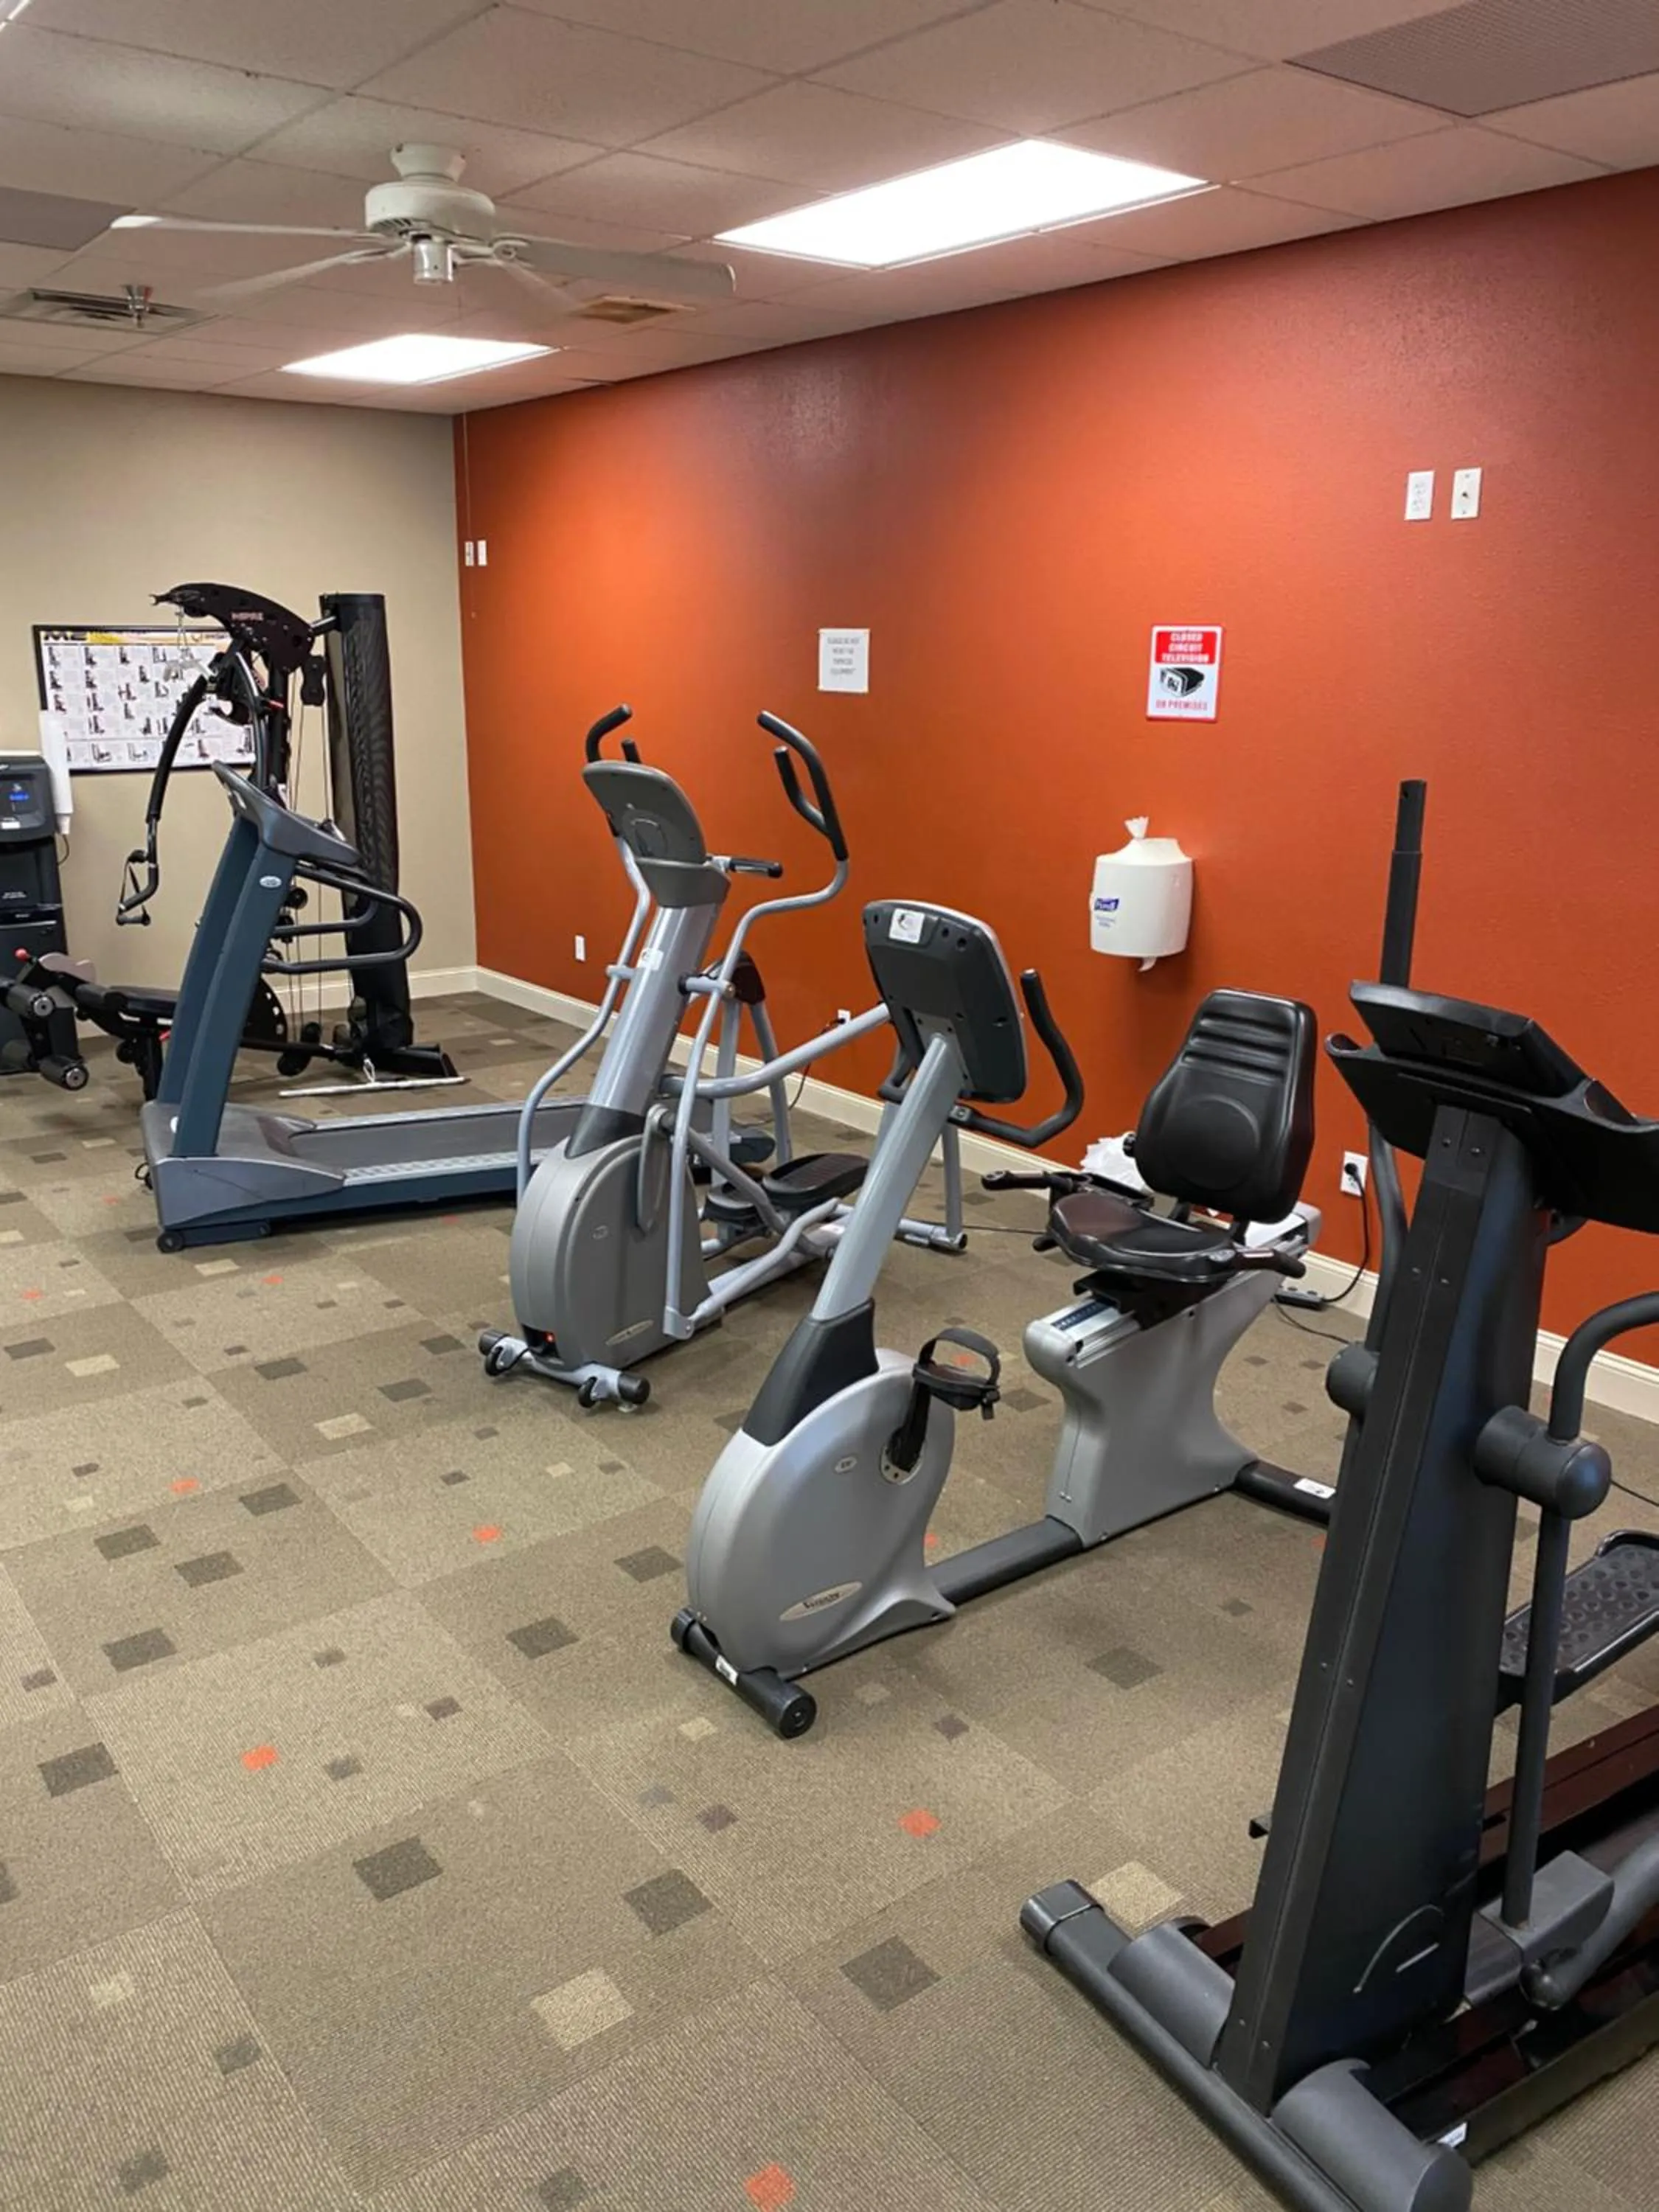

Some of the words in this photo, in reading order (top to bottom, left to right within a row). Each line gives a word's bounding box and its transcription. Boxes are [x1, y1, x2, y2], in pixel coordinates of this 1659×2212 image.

[1169, 633, 1203, 642] CLOSED
[1168, 642, 1203, 653] CIRCUIT
[1161, 653, 1209, 663] TELEVISION
